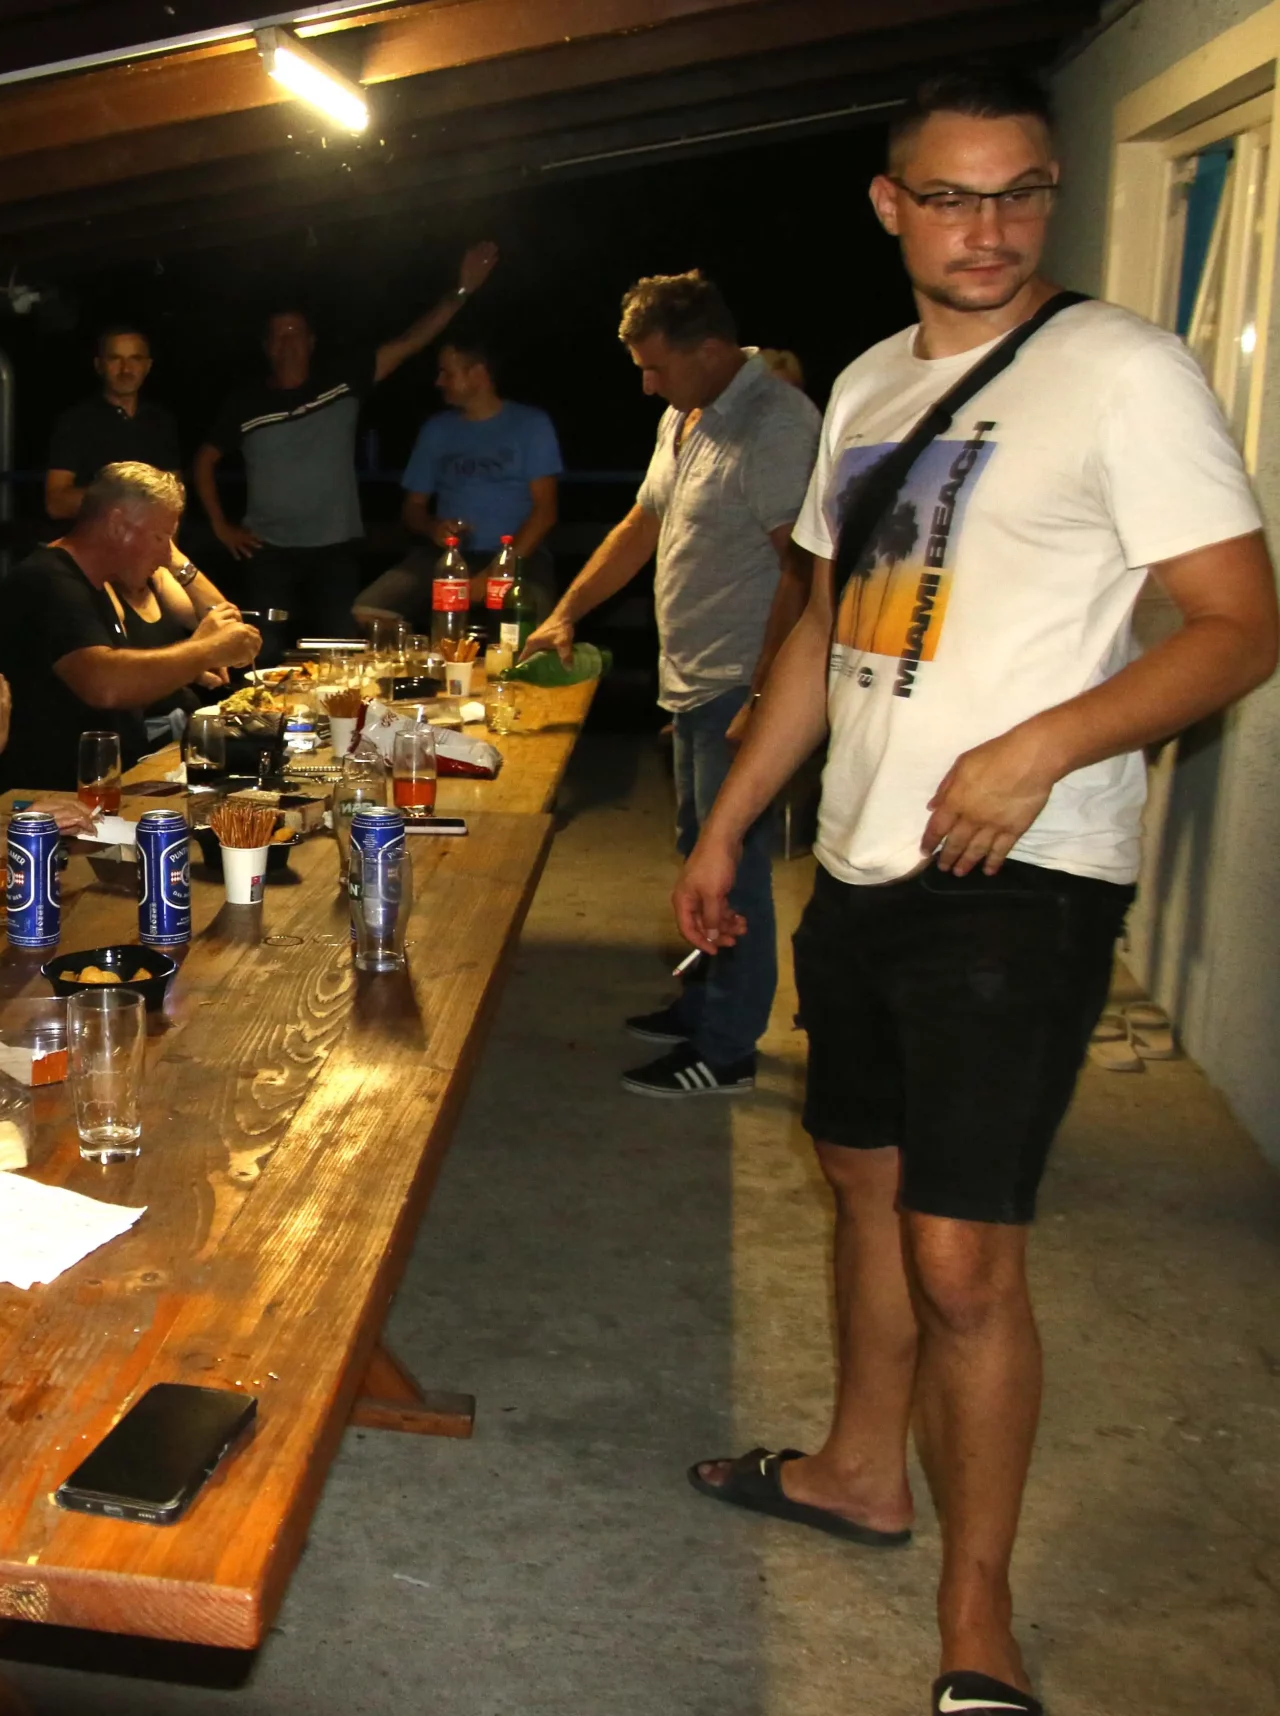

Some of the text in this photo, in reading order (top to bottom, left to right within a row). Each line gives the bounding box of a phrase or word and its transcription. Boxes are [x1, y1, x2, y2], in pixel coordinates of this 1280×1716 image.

[892, 420, 997, 698] MIAMI BEACH
[169, 848, 189, 863] PUNT
